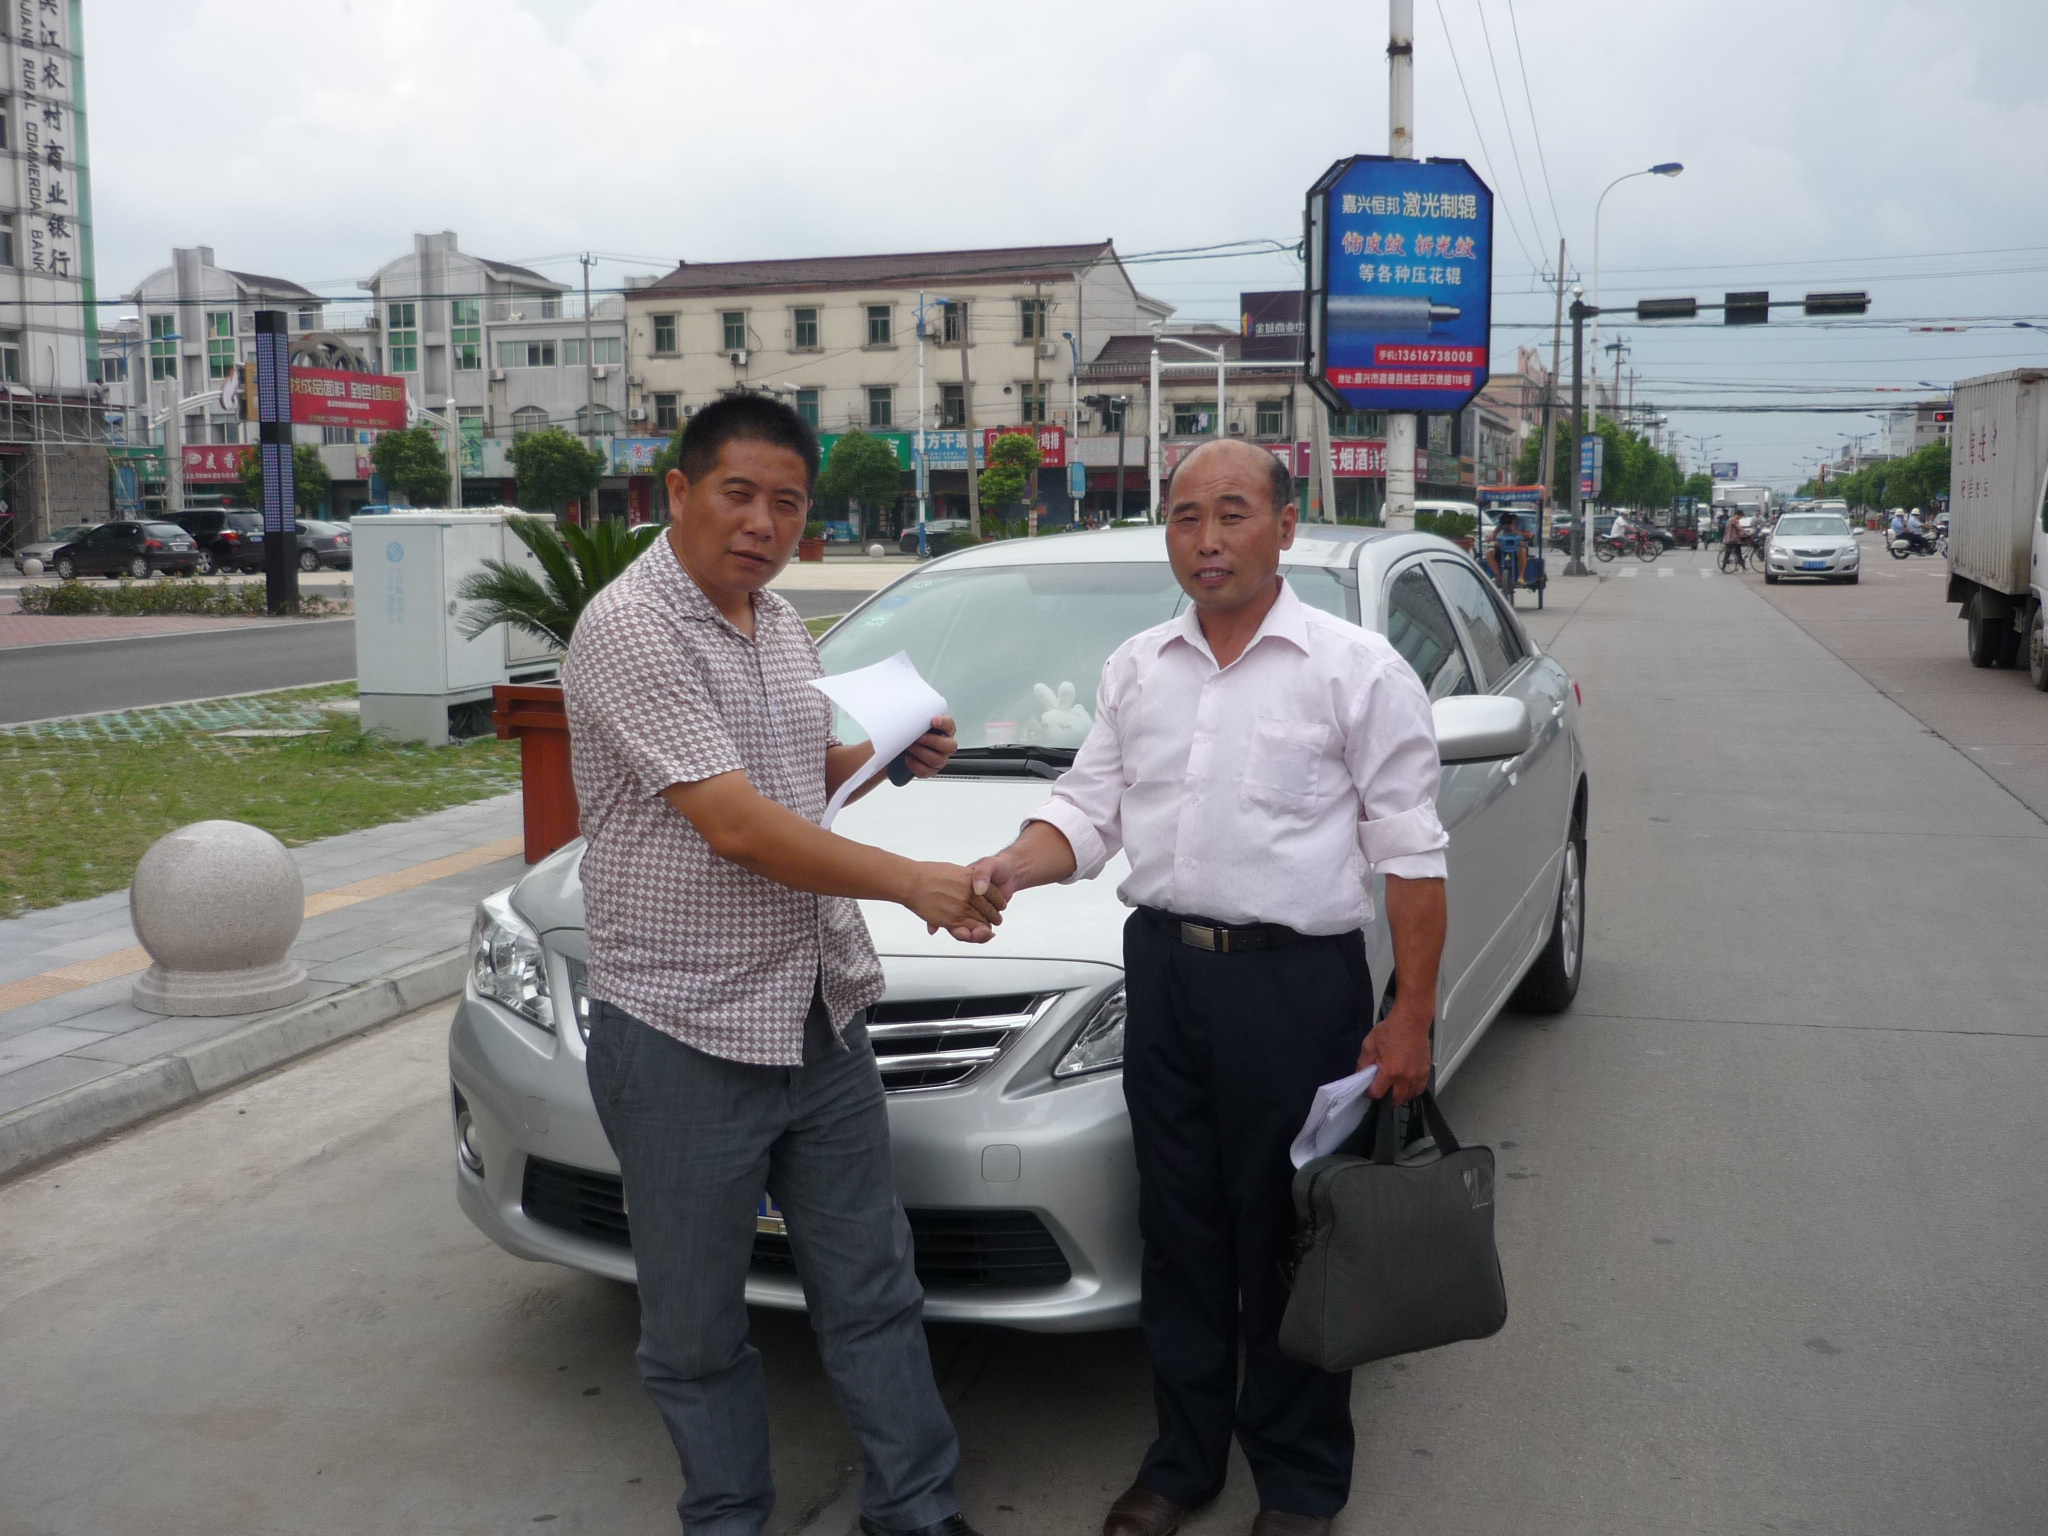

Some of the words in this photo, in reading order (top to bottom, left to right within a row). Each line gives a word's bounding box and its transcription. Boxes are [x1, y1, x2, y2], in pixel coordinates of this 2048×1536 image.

[20, 0, 34, 48] JIANG
[22, 59, 36, 111] RURAL
[25, 121, 43, 220] COMMERCIAL
[31, 230, 45, 272] BANK
[1342, 231, 1406, 256] 仿皮纹
[1359, 264, 1461, 286] 等各种压花辊
[1037, 432, 1060, 450] 鸡排
